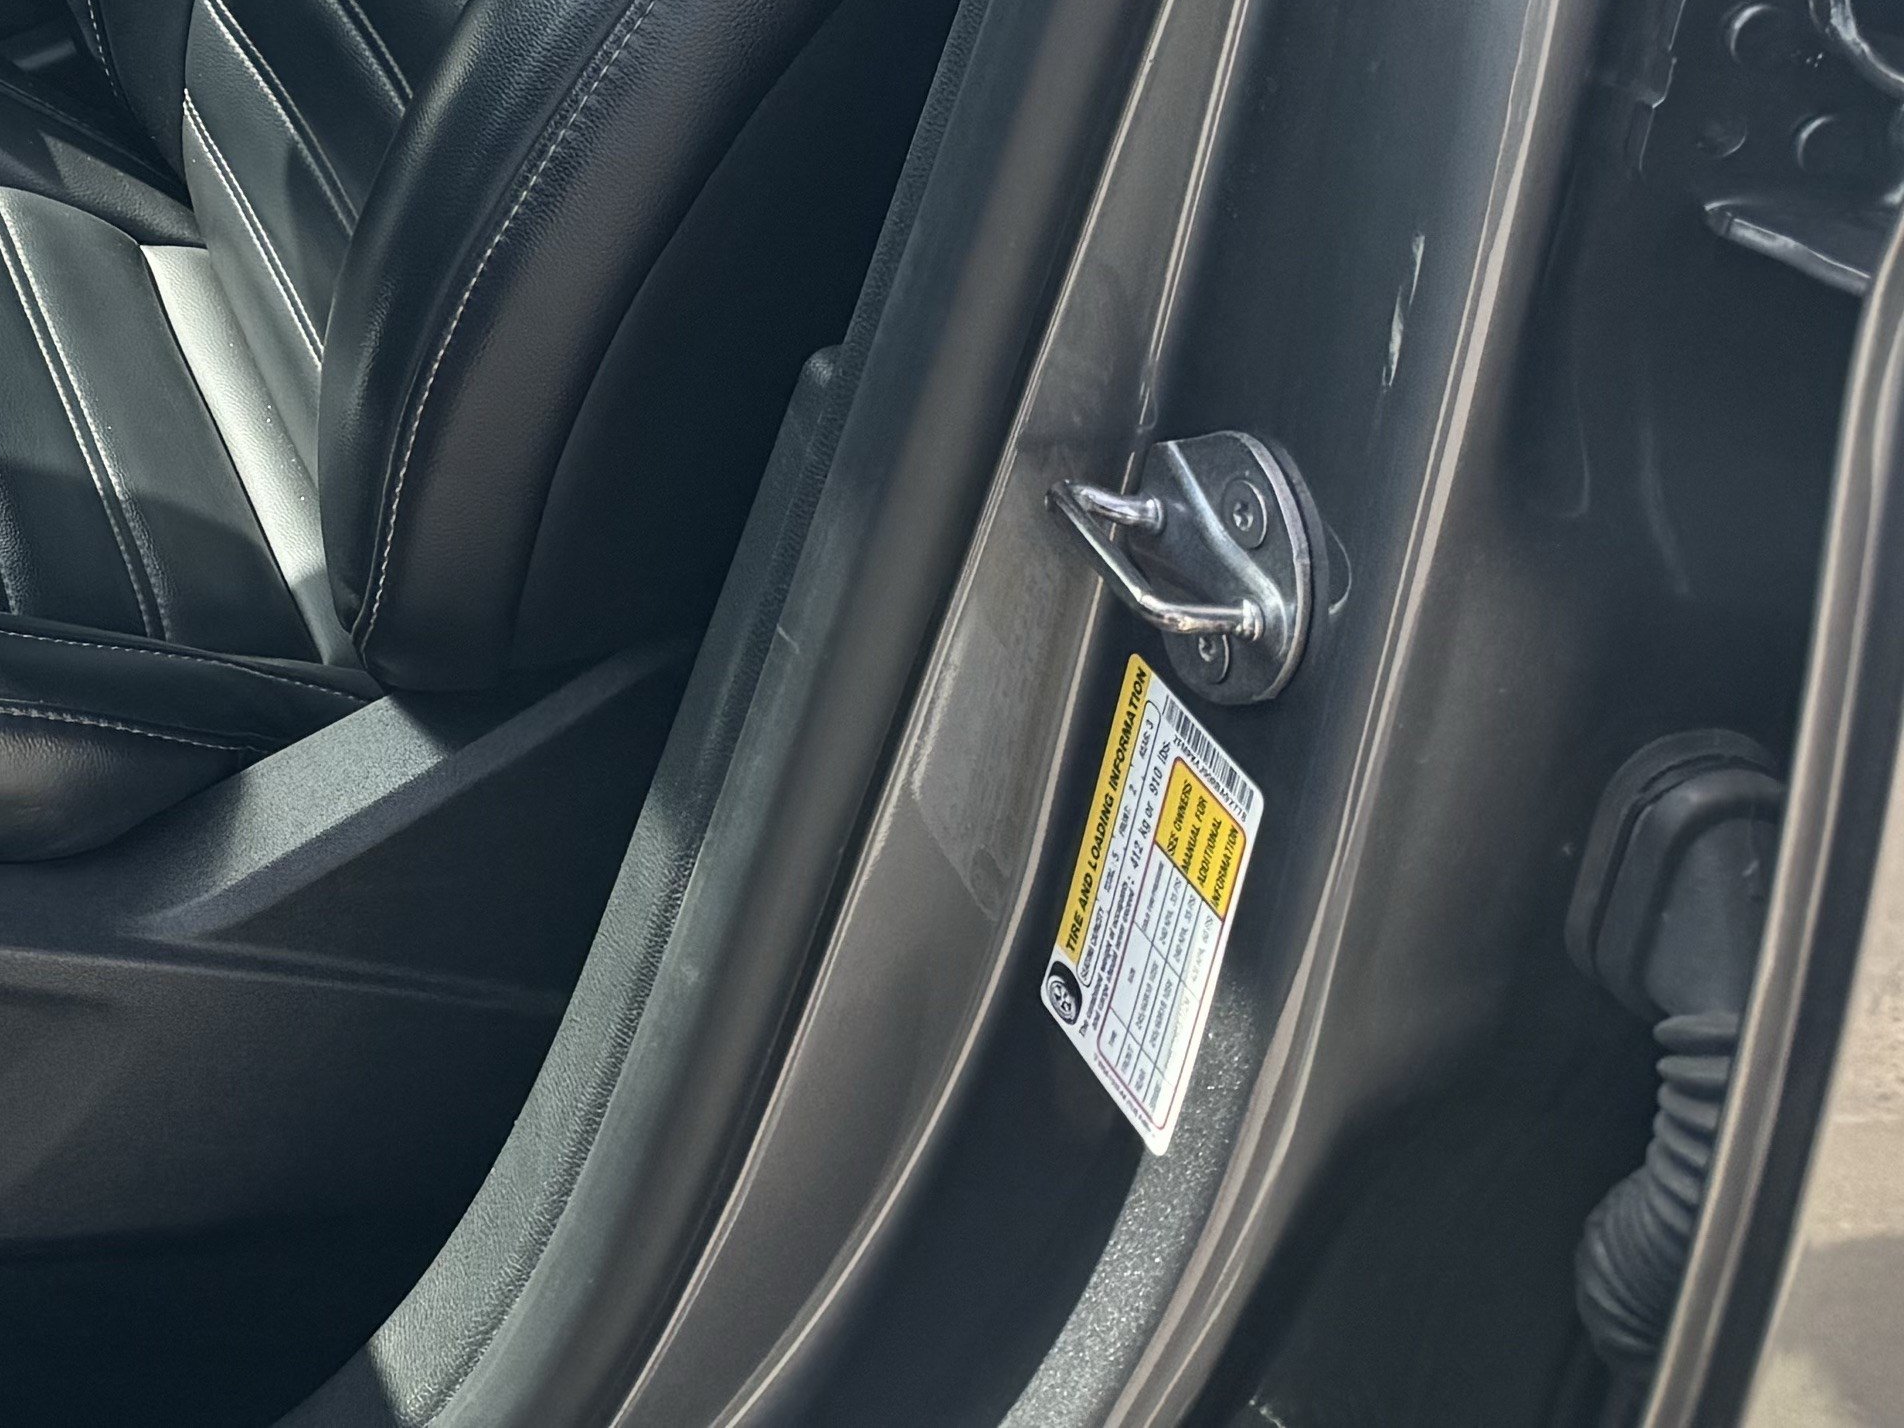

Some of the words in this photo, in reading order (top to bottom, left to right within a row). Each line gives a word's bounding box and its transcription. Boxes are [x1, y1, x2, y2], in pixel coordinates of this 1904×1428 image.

[1066, 910, 1082, 955] TIRE
[1078, 870, 1092, 911] AND
[1088, 791, 1113, 871] LOADING
[1108, 666, 1146, 791] INFORMATION
[1130, 839, 1142, 870] 412
[1138, 816, 1150, 840] kg
[1145, 801, 1153, 818] or
[1149, 765, 1161, 796] 910
[1166, 829, 1178, 857] SEE
[1181, 820, 1199, 874] MANUAL
[1195, 794, 1206, 822] FOR
[1196, 813, 1221, 887] ADDITIONAL
[1210, 825, 1238, 909] INFORMATION
